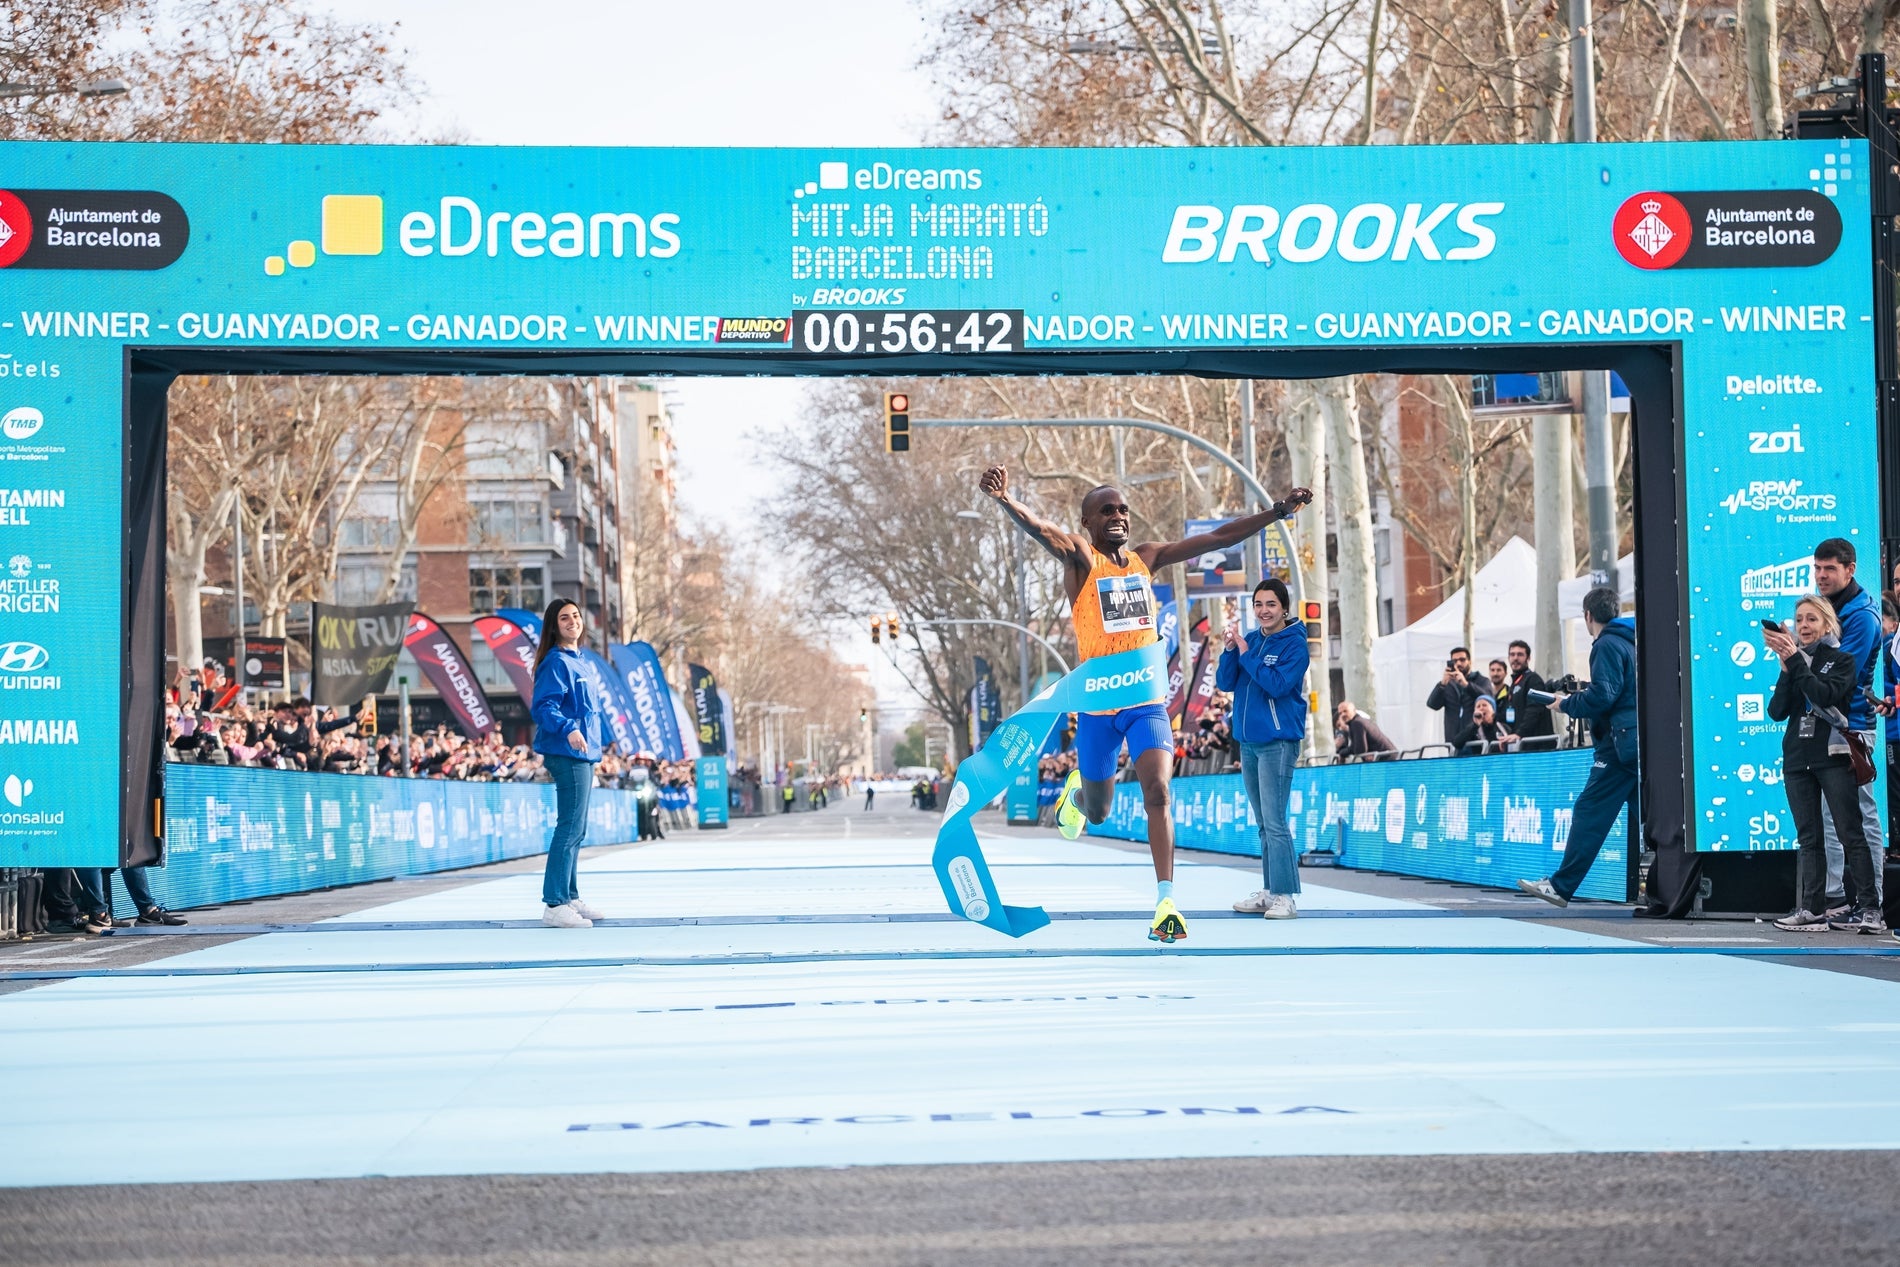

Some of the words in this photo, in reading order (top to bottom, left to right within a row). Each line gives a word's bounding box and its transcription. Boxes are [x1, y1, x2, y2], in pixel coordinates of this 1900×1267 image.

[855, 162, 983, 190] eDreams
[47, 208, 137, 226] Ajuntament
[142, 208, 162, 223] de
[792, 203, 894, 237] MITJA
[910, 196, 1049, 237] MARATÓ
[1705, 207, 1792, 224] Ajuntament
[1796, 206, 1815, 222] de
[47, 227, 162, 248] Barcelona
[400, 196, 682, 258] eDreams
[1162, 202, 1505, 263] BROOKS
[1705, 225, 1816, 246] Barcelona
[792, 245, 993, 279] BARCELONA
[792, 294, 807, 307] by
[811, 288, 907, 305] BROOKS
[21, 311, 150, 338] WINNER
[177, 312, 380, 340] GUANYADOR
[407, 314, 567, 341] GANADOR
[594, 315, 719, 342] WINNER
[723, 319, 786, 333] MUNDO
[803, 312, 1013, 353] 00:56:42
[1160, 313, 1288, 340] WINNER
[1314, 310, 1512, 338] GUANYADOR
[1538, 308, 1694, 336] GANADOR
[1720, 305, 1846, 332] WINNER
[720, 331, 771, 339] DEPORTIVO
[1726, 374, 1823, 395] Deloitte.
[10, 419, 37, 429] TMB
[1749, 479, 1798, 497] RPM
[1750, 494, 1837, 511] SPORTS
[1775, 514, 1787, 524] By
[0, 676, 61, 690] UNDAI
[1084, 665, 1155, 692] BROOKS
[0, 719, 79, 745] AMAHA
[961, 864, 977, 898] Barcelona
[566, 1106, 1359, 1132] BARCELONA
